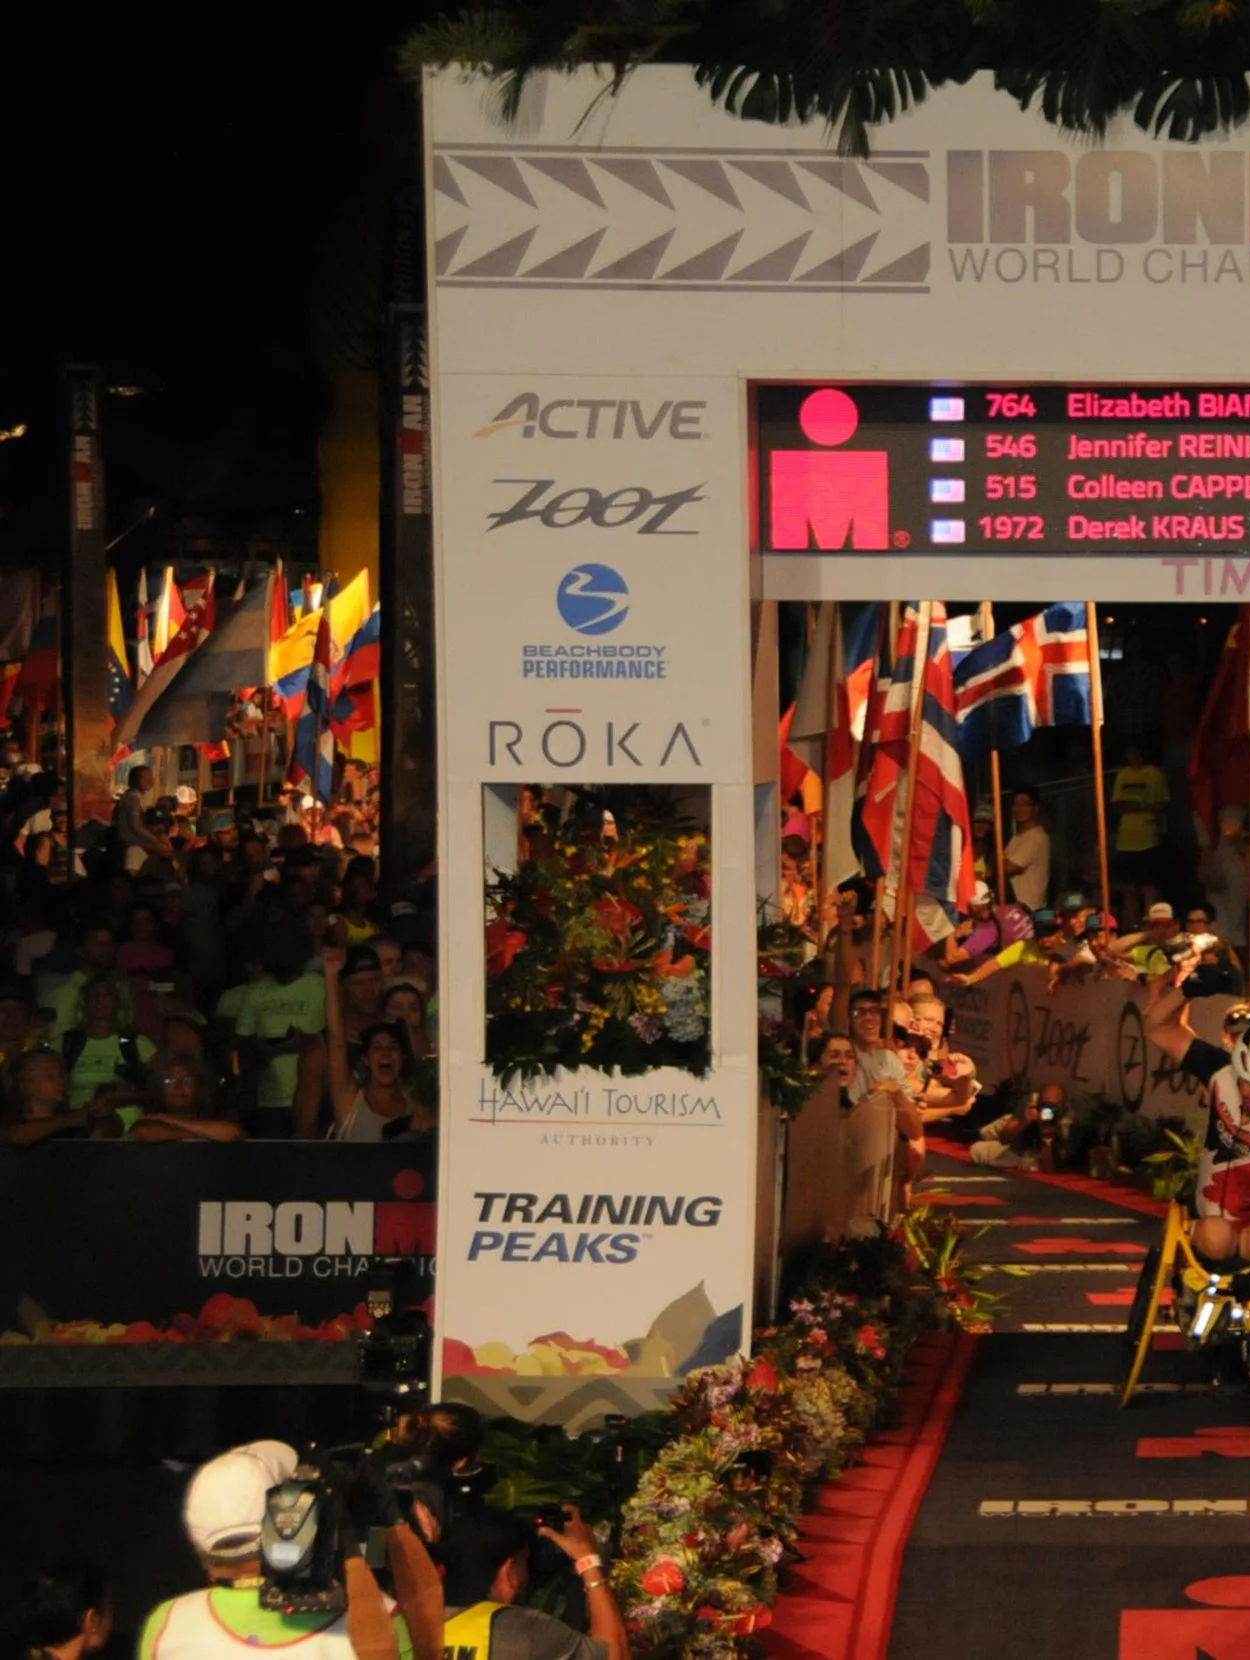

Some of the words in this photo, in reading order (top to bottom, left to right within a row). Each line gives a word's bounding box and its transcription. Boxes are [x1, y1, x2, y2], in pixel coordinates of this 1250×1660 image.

[948, 247, 1125, 285] WORLD
[473, 391, 708, 441] ACTIVE
[986, 394, 1036, 418] 764
[1068, 394, 1190, 418] Elizabeth
[986, 435, 1036, 459] 546
[1067, 435, 1172, 459] Jennifer
[986, 476, 1036, 500] 515
[1068, 476, 1164, 500] Colleen
[979, 516, 1045, 540] 1972
[1068, 516, 1147, 540] Derek
[1152, 516, 1245, 540] KRAUS
[522, 644, 667, 658] BEACHBODY
[522, 659, 667, 680] PERFORMANCE
[602, 1088, 722, 1120] TOURISM
[539, 1133, 657, 1147] AUTHORITY
[473, 1192, 724, 1228] TRAINING
[466, 1230, 642, 1265] PEAKS
[199, 1256, 303, 1278] WORLD
